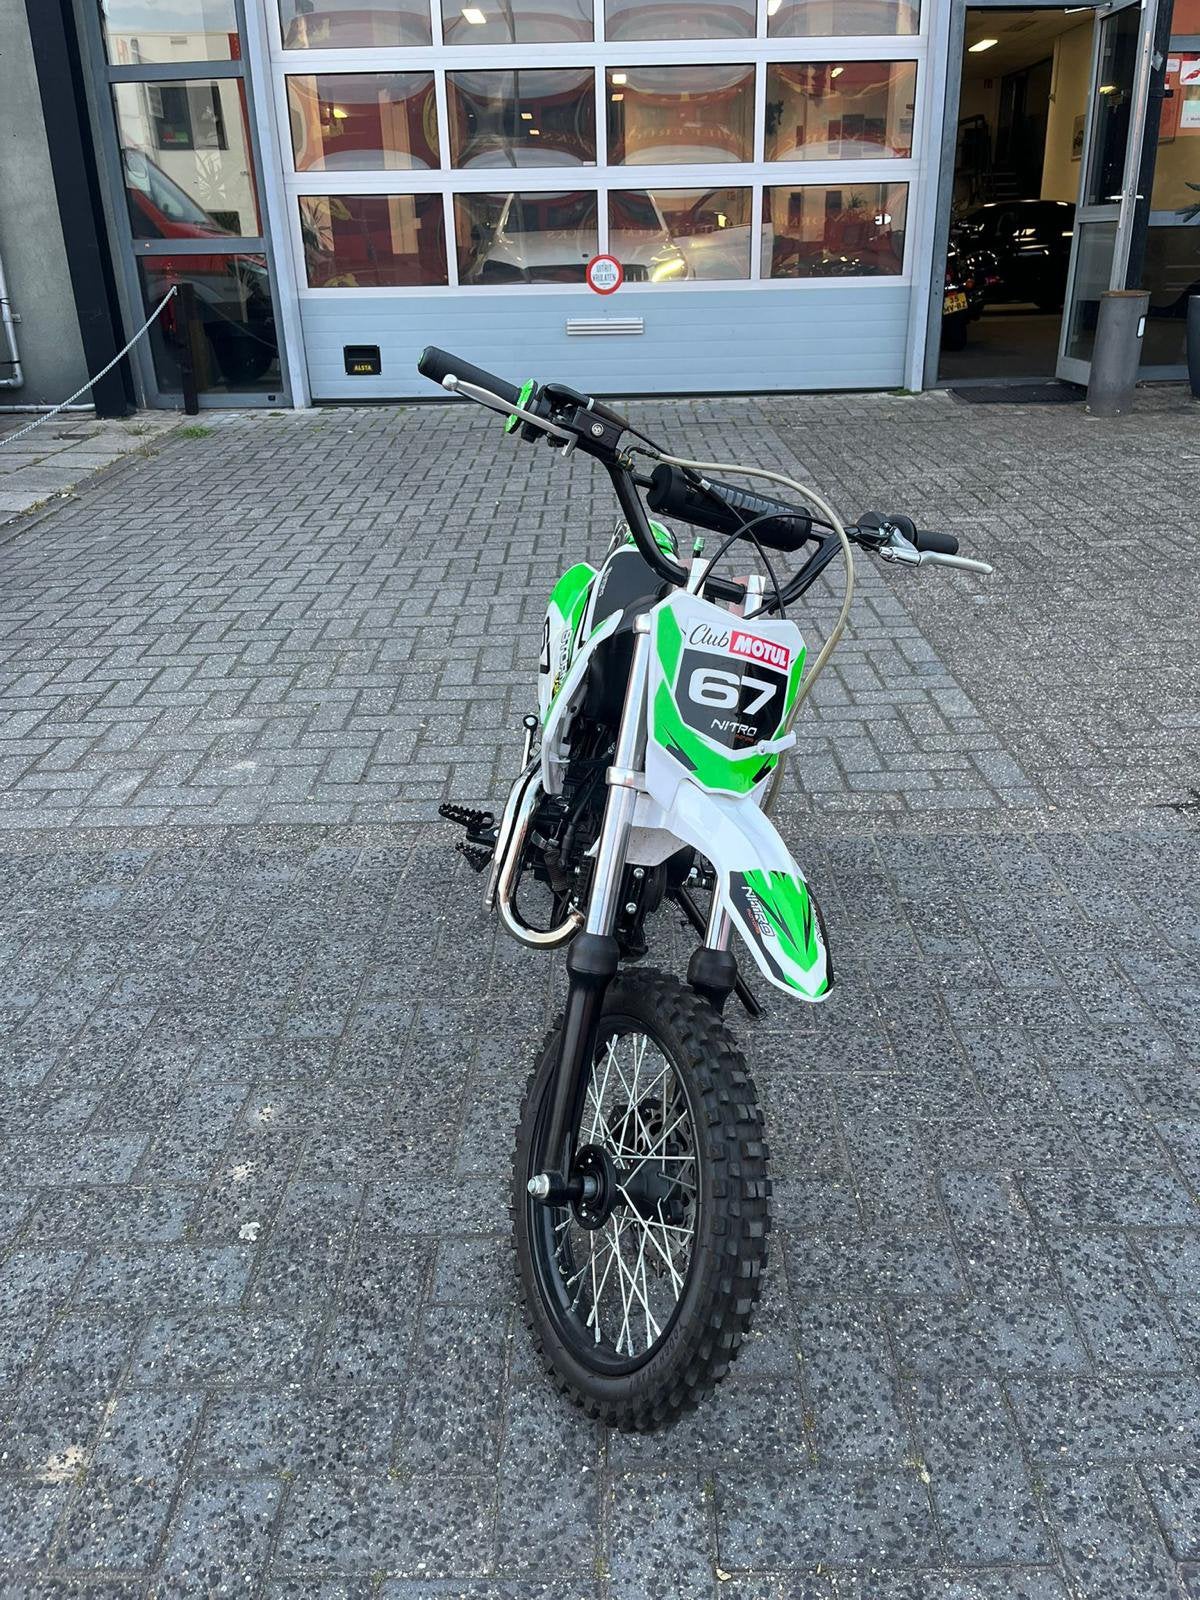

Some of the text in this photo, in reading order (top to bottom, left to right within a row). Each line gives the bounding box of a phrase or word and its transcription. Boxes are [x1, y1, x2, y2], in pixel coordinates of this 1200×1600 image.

[690, 624, 787, 666] Club MOTUL
[689, 668, 777, 715] 67
[711, 719, 757, 737] NITRO
[741, 886, 775, 937] NITRO
